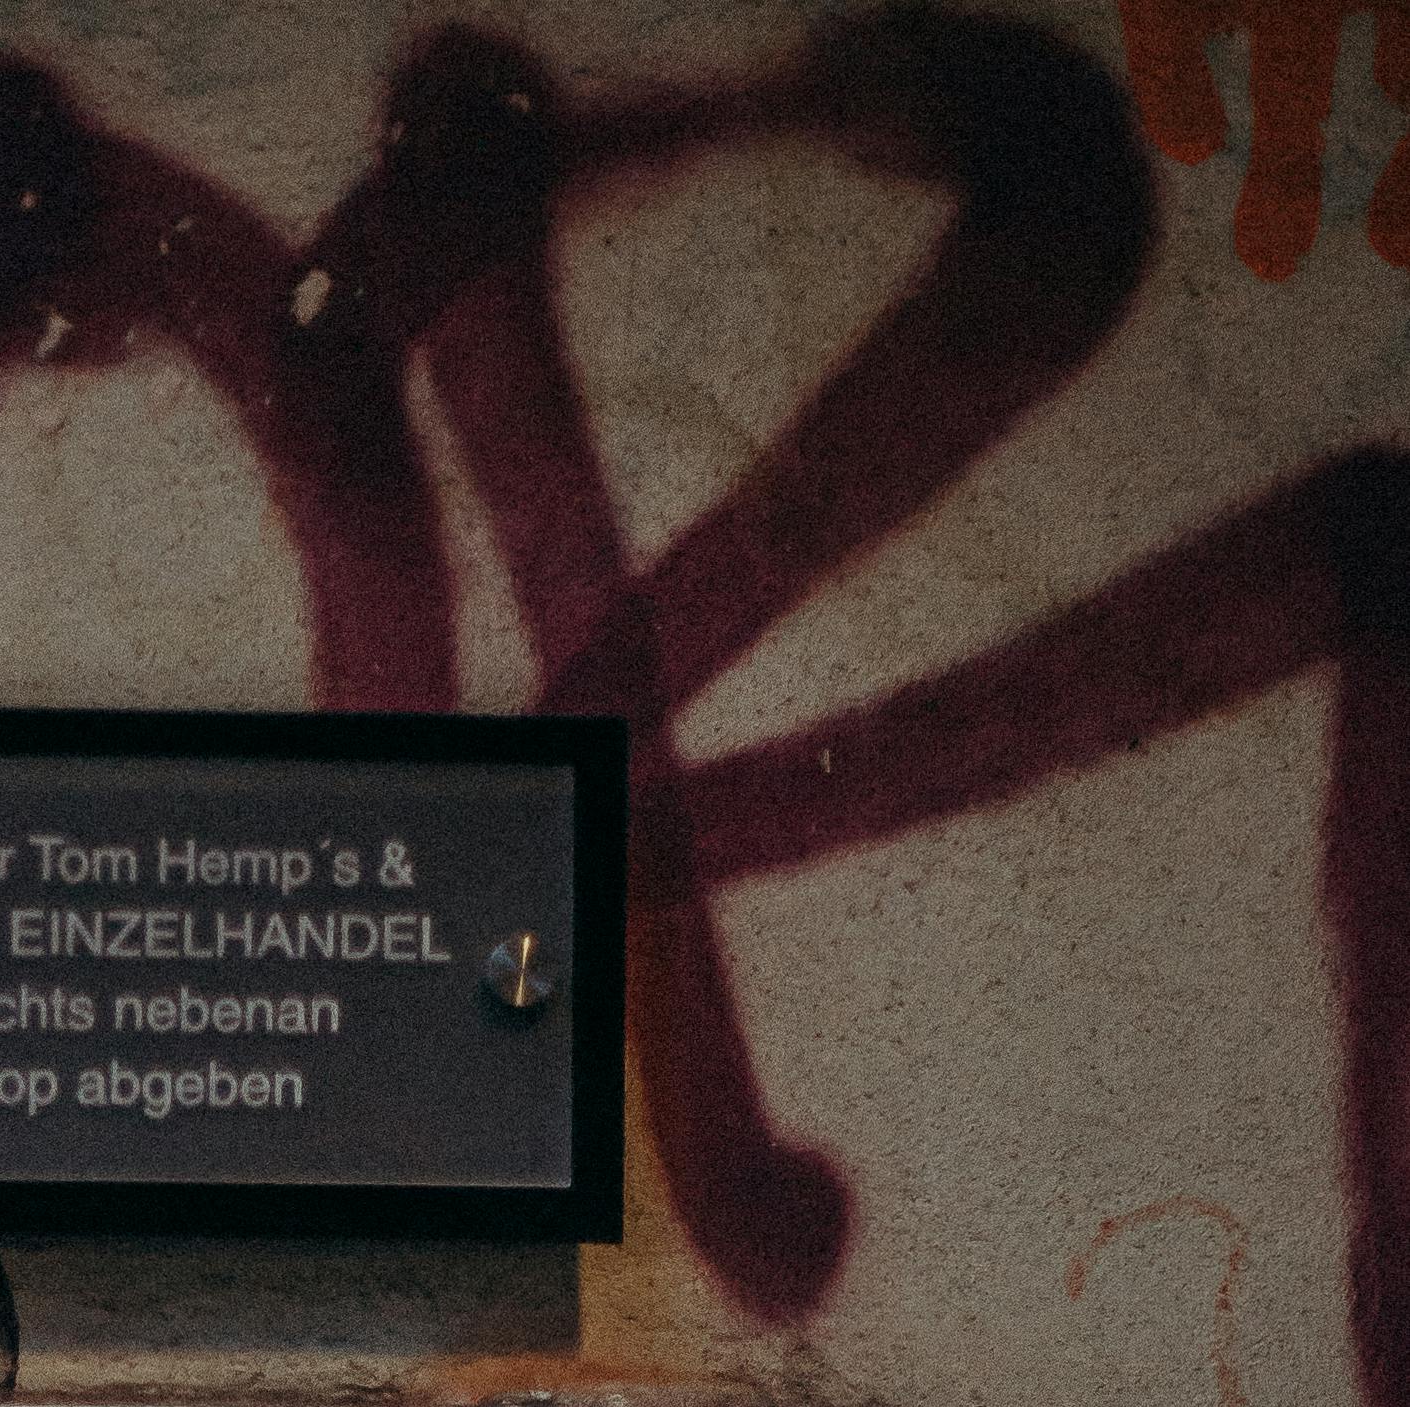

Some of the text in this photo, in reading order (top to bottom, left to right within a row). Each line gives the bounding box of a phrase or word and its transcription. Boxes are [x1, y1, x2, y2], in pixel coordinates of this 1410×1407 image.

[29, 836, 138, 884] Tom
[378, 841, 415, 887] &
[9, 910, 451, 963] EINZELHANDEL
[113, 988, 341, 1034] nebenan
[77, 1060, 304, 1119] abgeben
